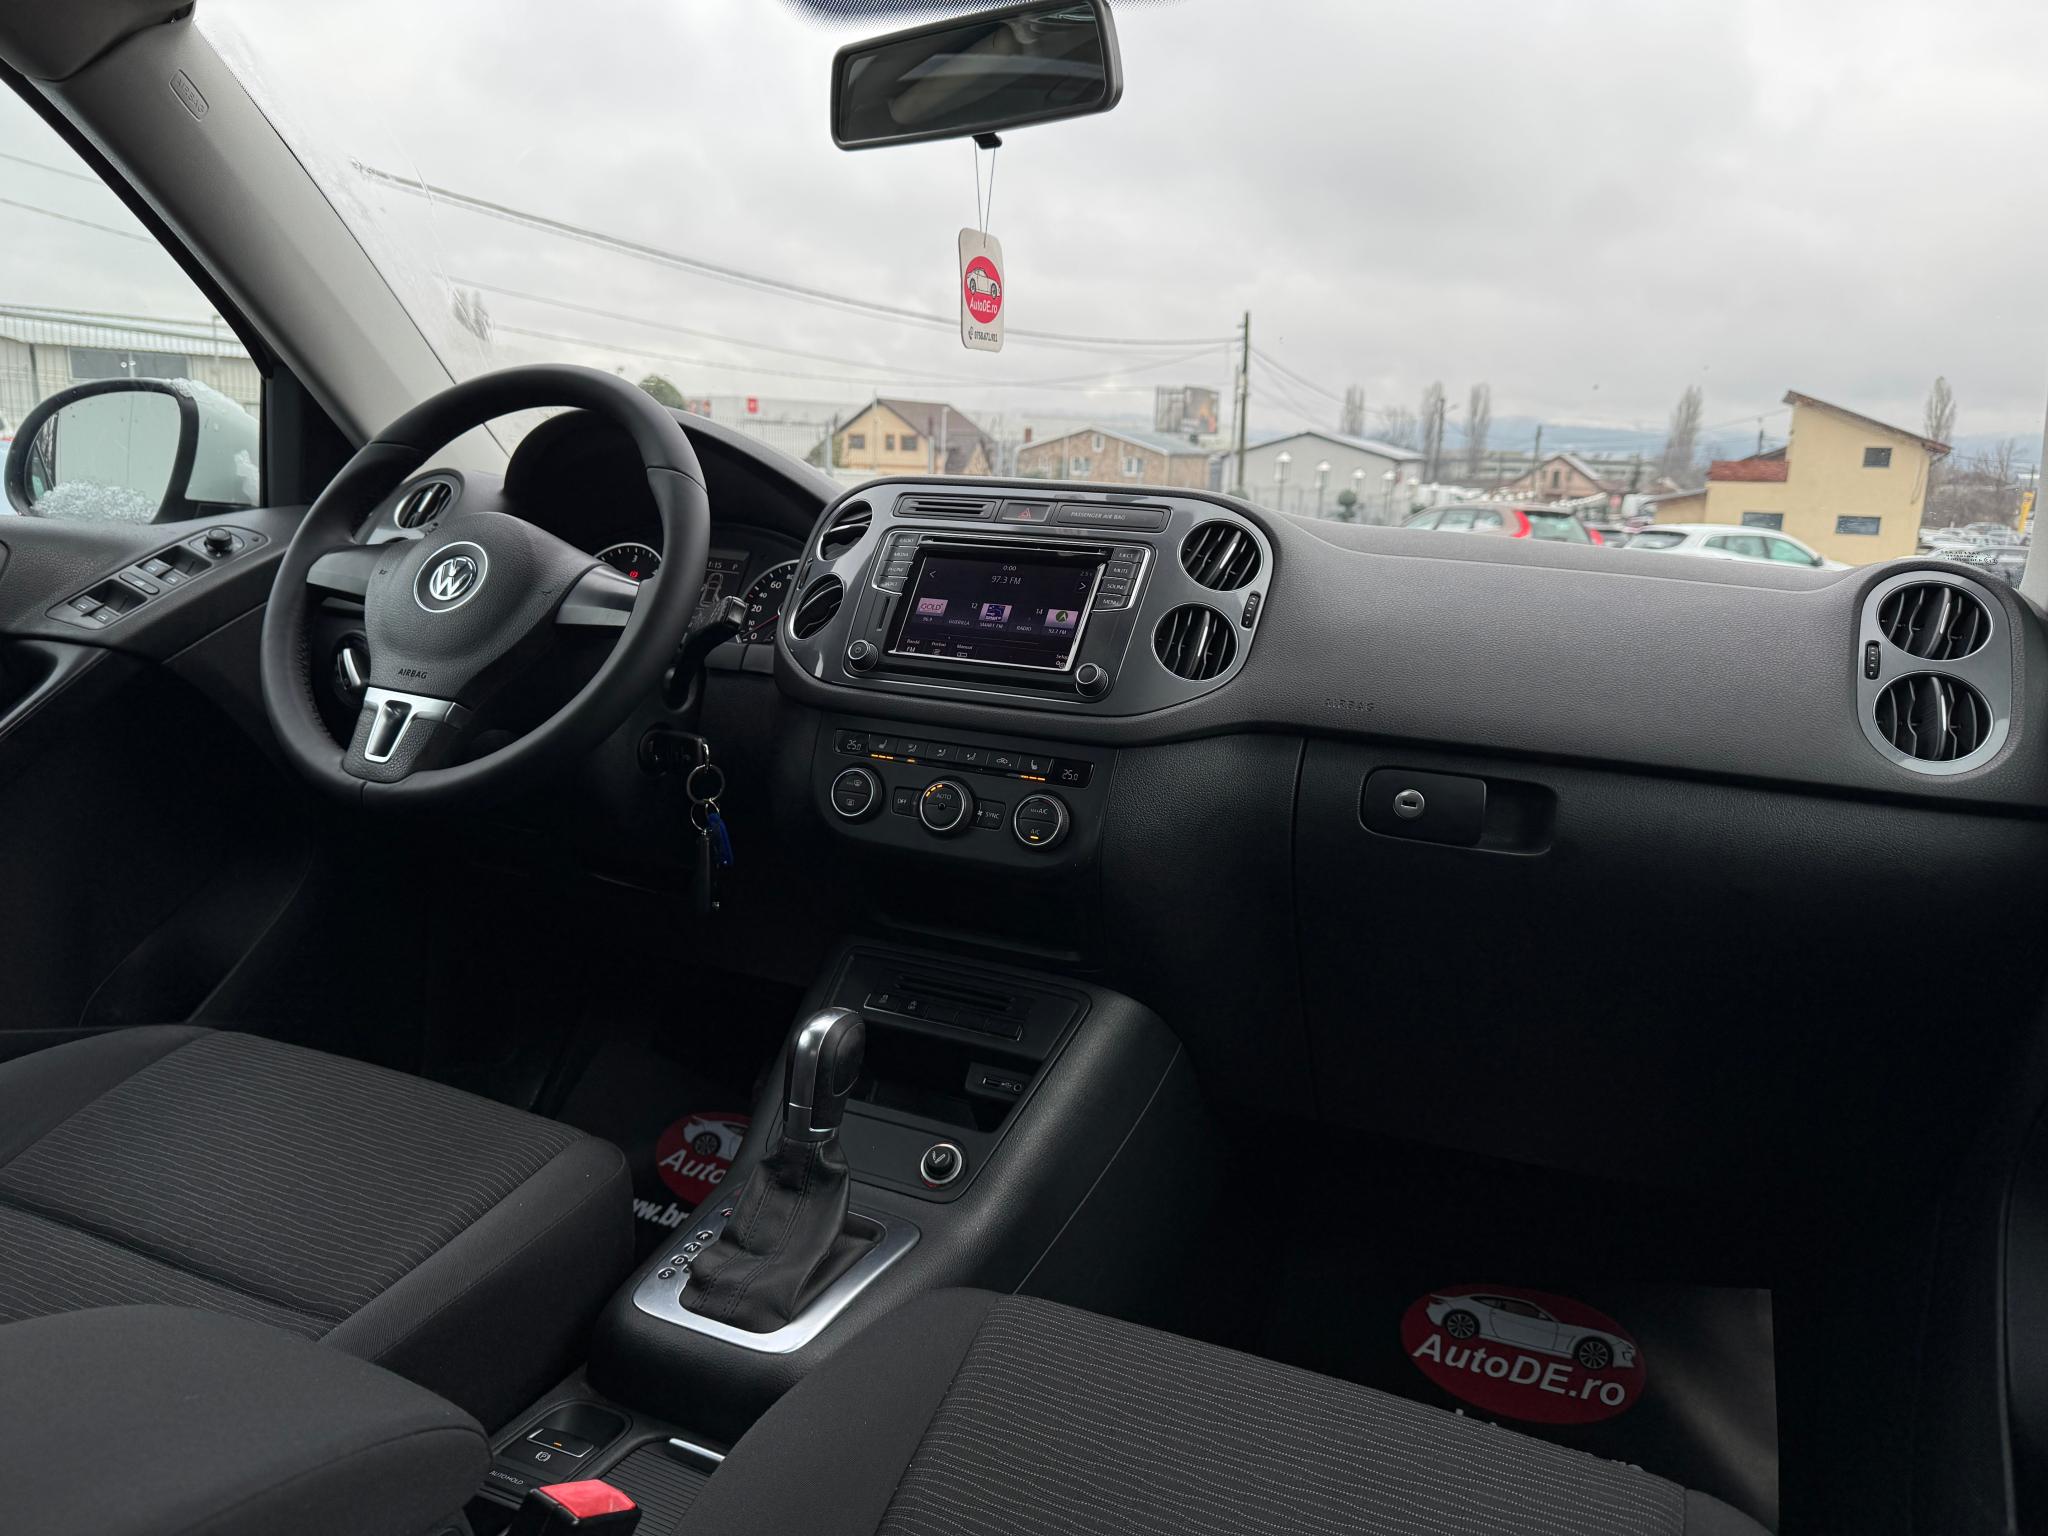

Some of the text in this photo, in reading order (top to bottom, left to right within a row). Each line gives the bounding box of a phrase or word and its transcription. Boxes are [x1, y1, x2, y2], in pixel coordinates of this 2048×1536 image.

[969, 297, 998, 314] AutoDE.ro
[430, 556, 477, 600] VW
[991, 575, 1021, 585] 97.3 FM
[770, 581, 782, 589] 60
[751, 604, 762, 613] 20
[920, 602, 942, 611] GOLD
[750, 632, 758, 640] 0
[398, 668, 428, 679] AIRBAG
[985, 811, 1000, 820] SYNC
[1412, 1333, 1626, 1406] AutoDE.ro
